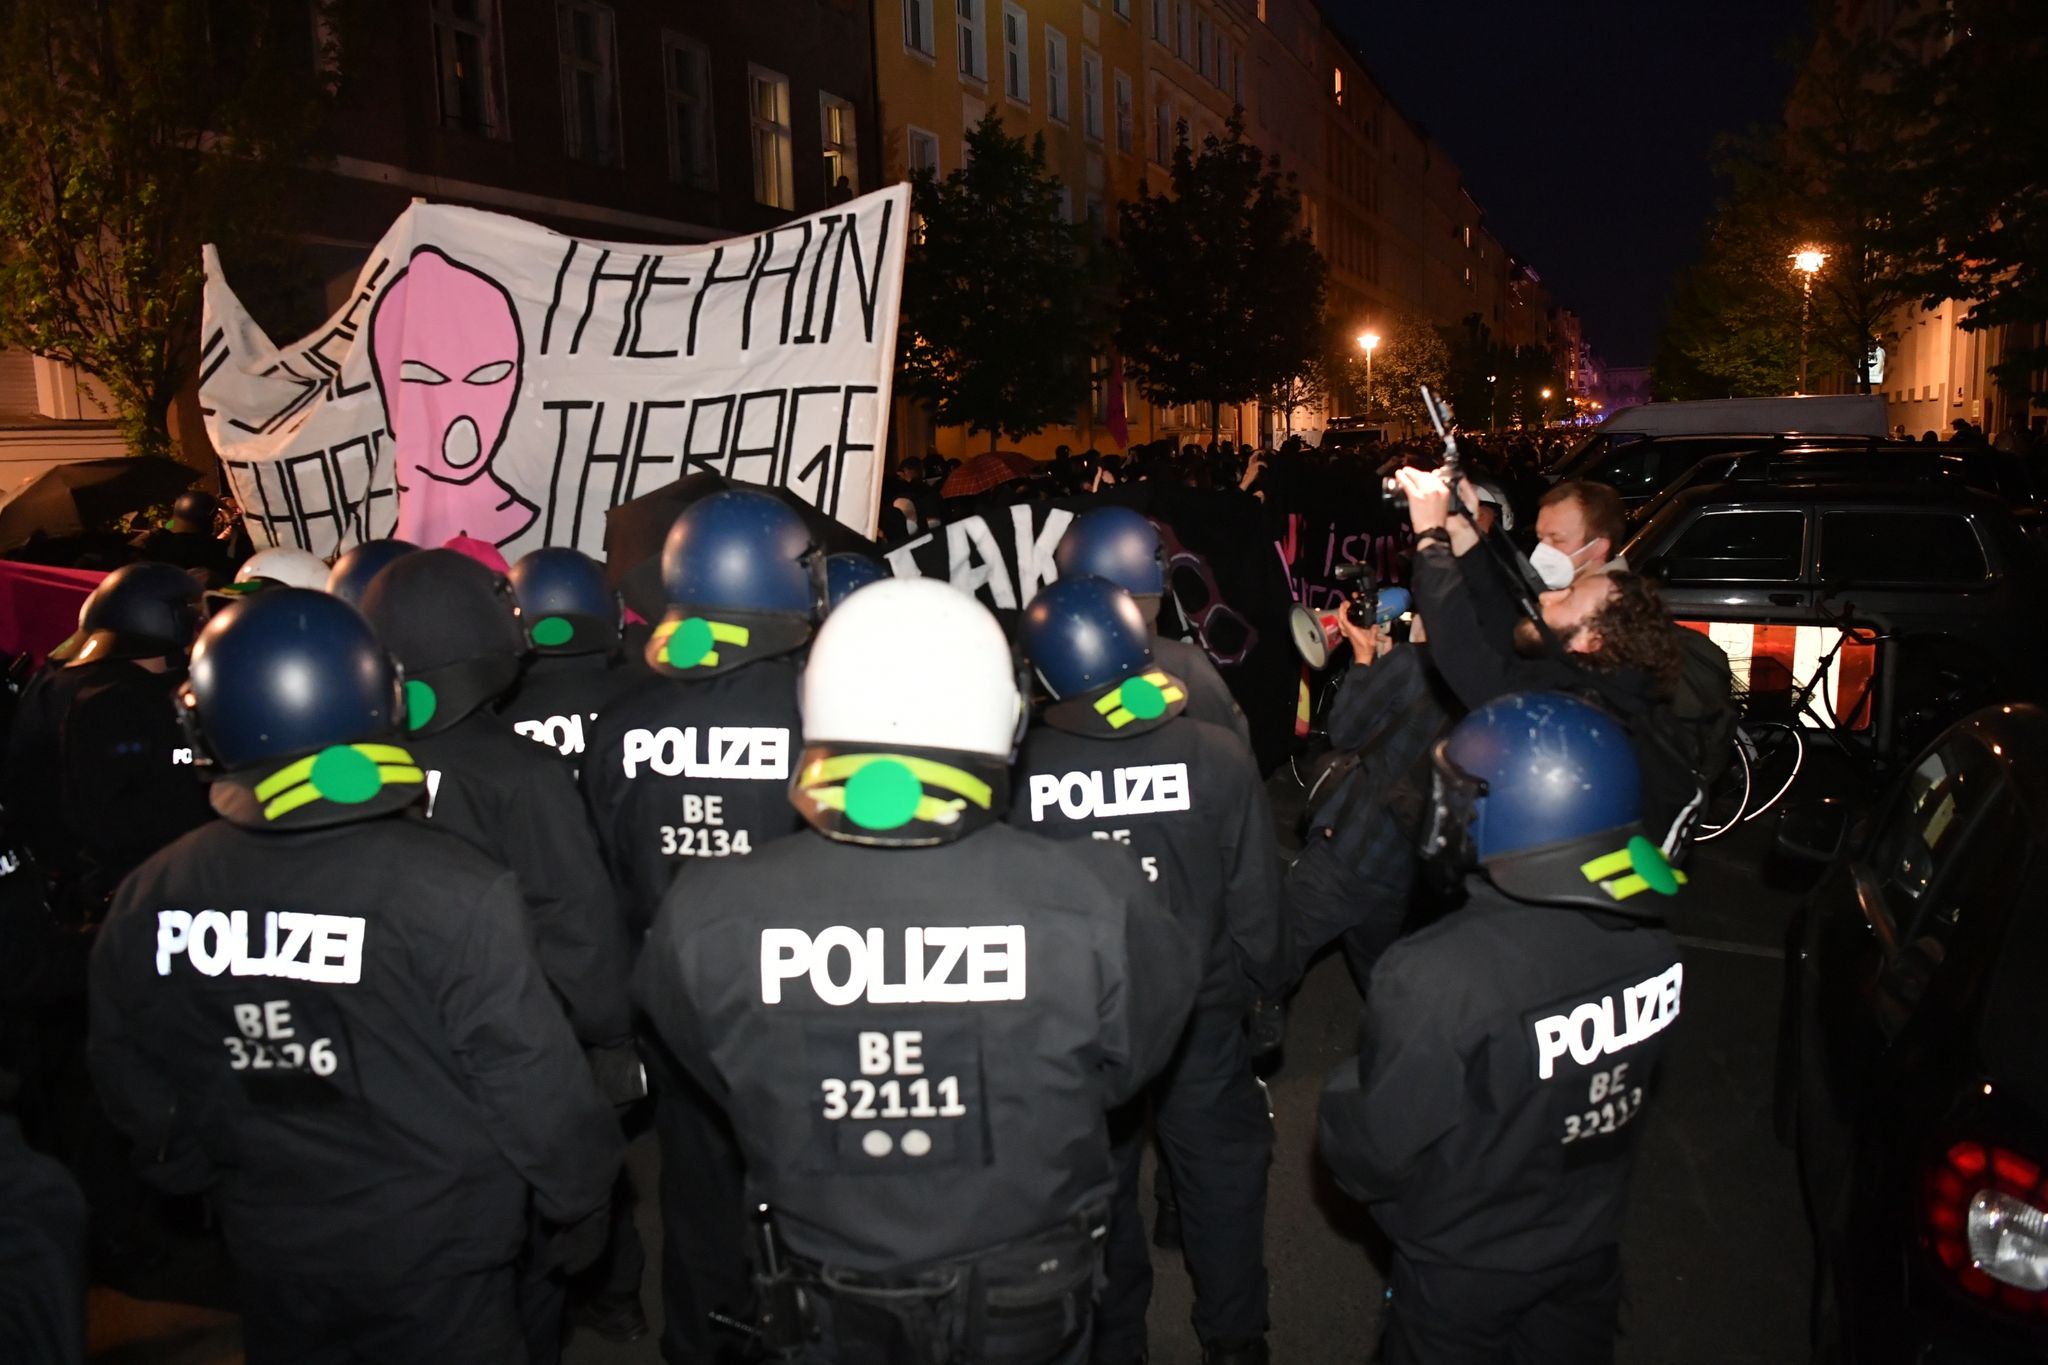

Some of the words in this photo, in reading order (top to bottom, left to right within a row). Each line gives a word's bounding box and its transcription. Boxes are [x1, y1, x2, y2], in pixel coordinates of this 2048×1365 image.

[540, 238, 691, 358] THE
[686, 198, 894, 358] PAIN
[542, 400, 686, 552] THE
[679, 385, 879, 520] RAGE
[622, 726, 790, 780] POLIZEI
[682, 793, 724, 826] BE
[1029, 762, 1191, 822] POLIZEI
[659, 823, 753, 858] 32134
[155, 909, 366, 984] POLIZEI
[760, 924, 1027, 1006] POLIZEI
[233, 999, 295, 1041] BE
[1534, 962, 1683, 1080] POLIZEI
[858, 1030, 928, 1076] BE
[821, 1074, 967, 1120] 32111
[1588, 1061, 1630, 1106] BE
